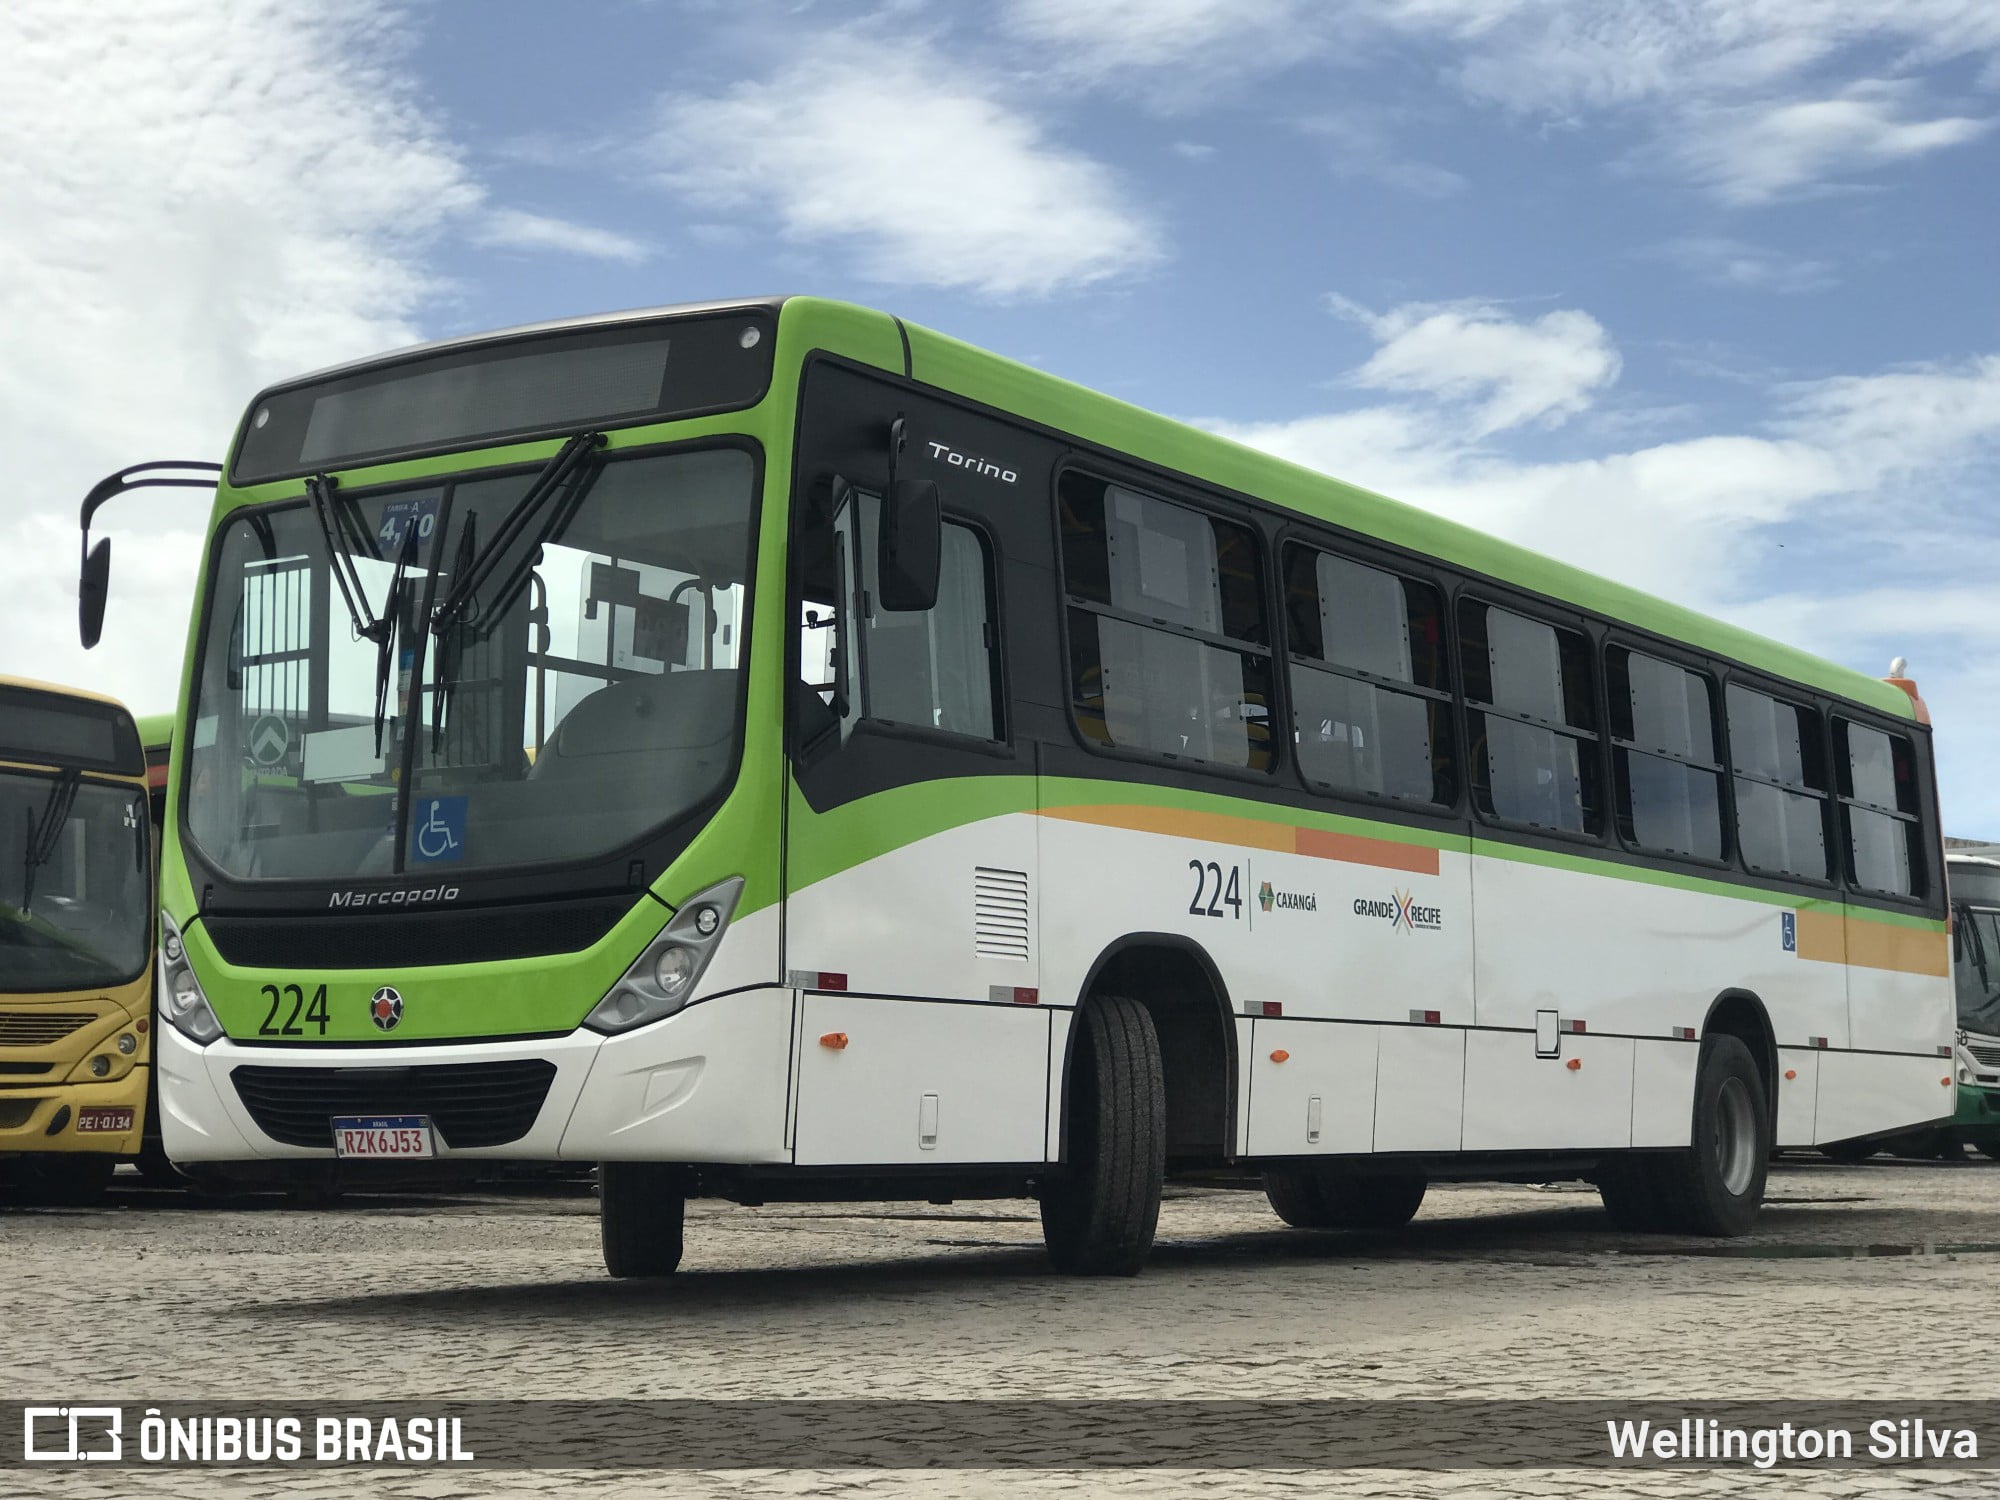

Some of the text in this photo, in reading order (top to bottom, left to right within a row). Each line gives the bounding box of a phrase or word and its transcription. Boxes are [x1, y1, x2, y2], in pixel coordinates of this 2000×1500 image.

[928, 441, 1017, 483] Torino
[328, 884, 460, 908] Marcopolo
[1189, 859, 1242, 920] 224
[1276, 891, 1318, 912] CAXANGÁ
[1353, 898, 1441, 924] GRANDE RECIFE
[258, 984, 331, 1036] 224
[344, 1130, 422, 1153] RZK6J53
